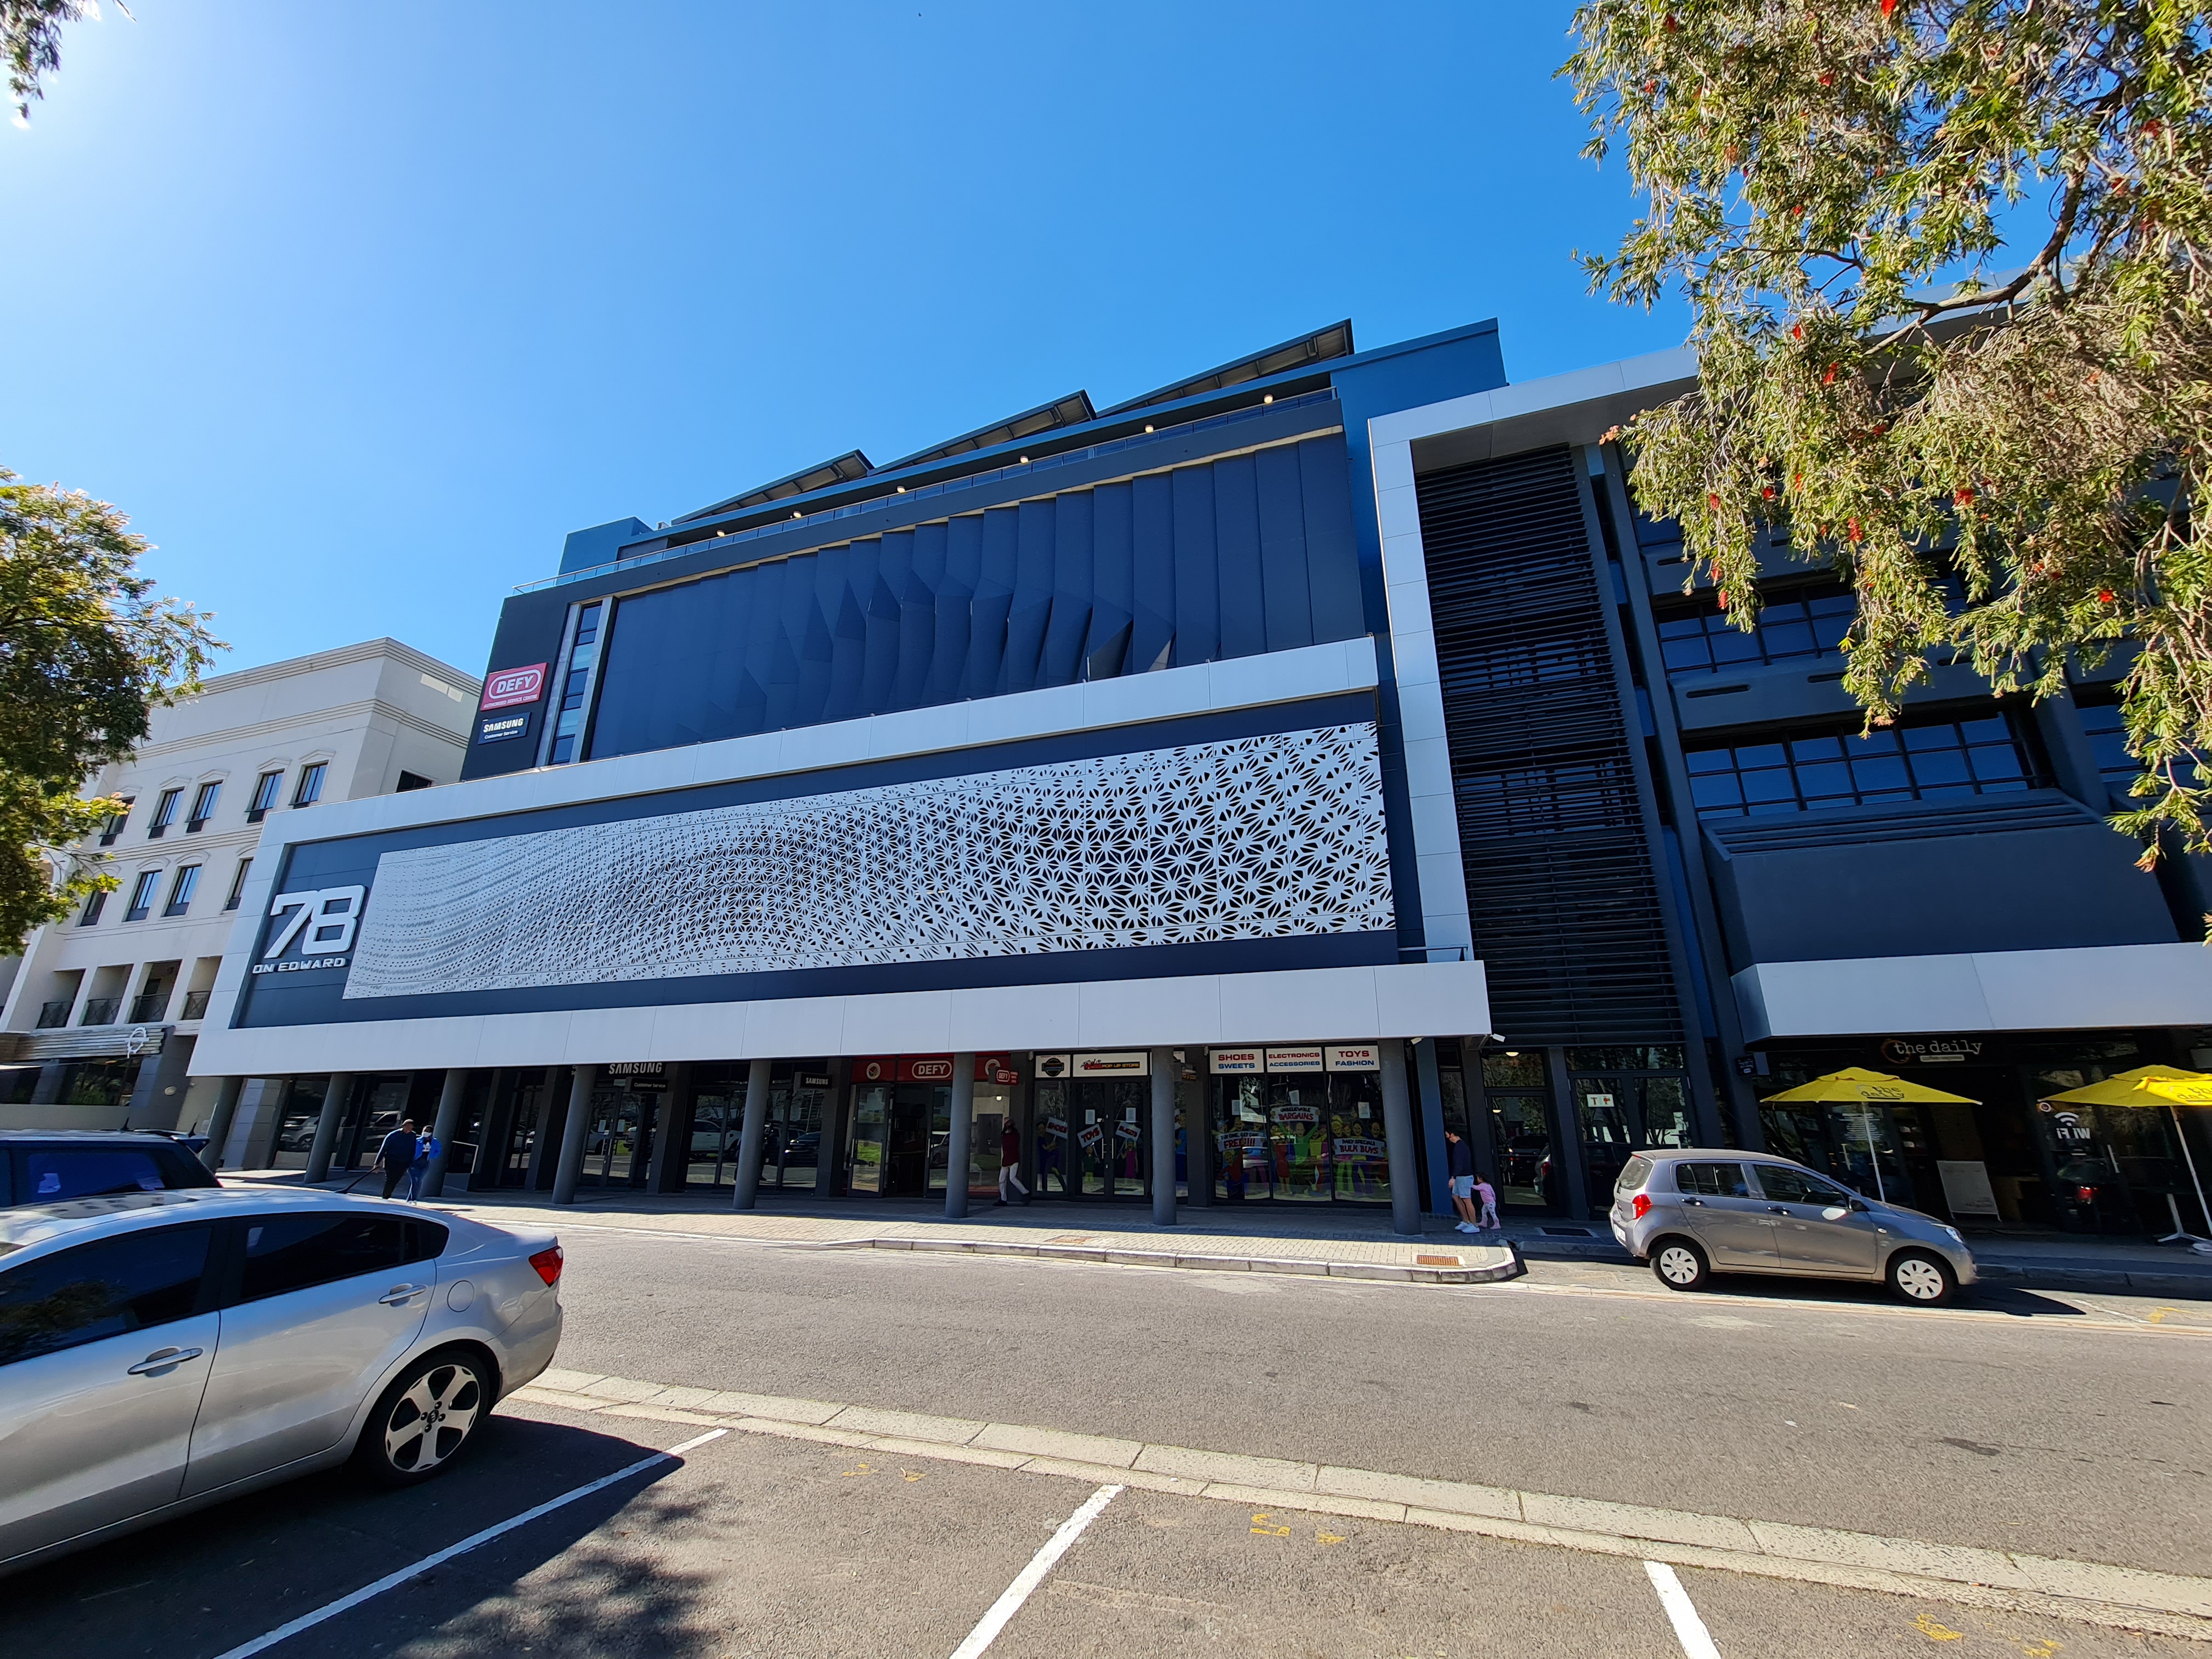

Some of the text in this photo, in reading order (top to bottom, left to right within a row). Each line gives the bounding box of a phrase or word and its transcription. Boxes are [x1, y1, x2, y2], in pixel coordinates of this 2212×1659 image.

[496, 675, 534, 693] DEFY
[483, 718, 524, 732] SAMSUNG
[264, 884, 366, 959] 78
[252, 957, 347, 974] ON EDWARD
[1894, 1040, 1983, 1055] the daily
[608, 1062, 662, 1075] SAMSUNG
[918, 1064, 947, 1075] DEFY
[805, 1077, 829, 1085] SAMSUNG
[1081, 1127, 1100, 1143] TOYS
[1360, 1145, 1379, 1154] BUYS
